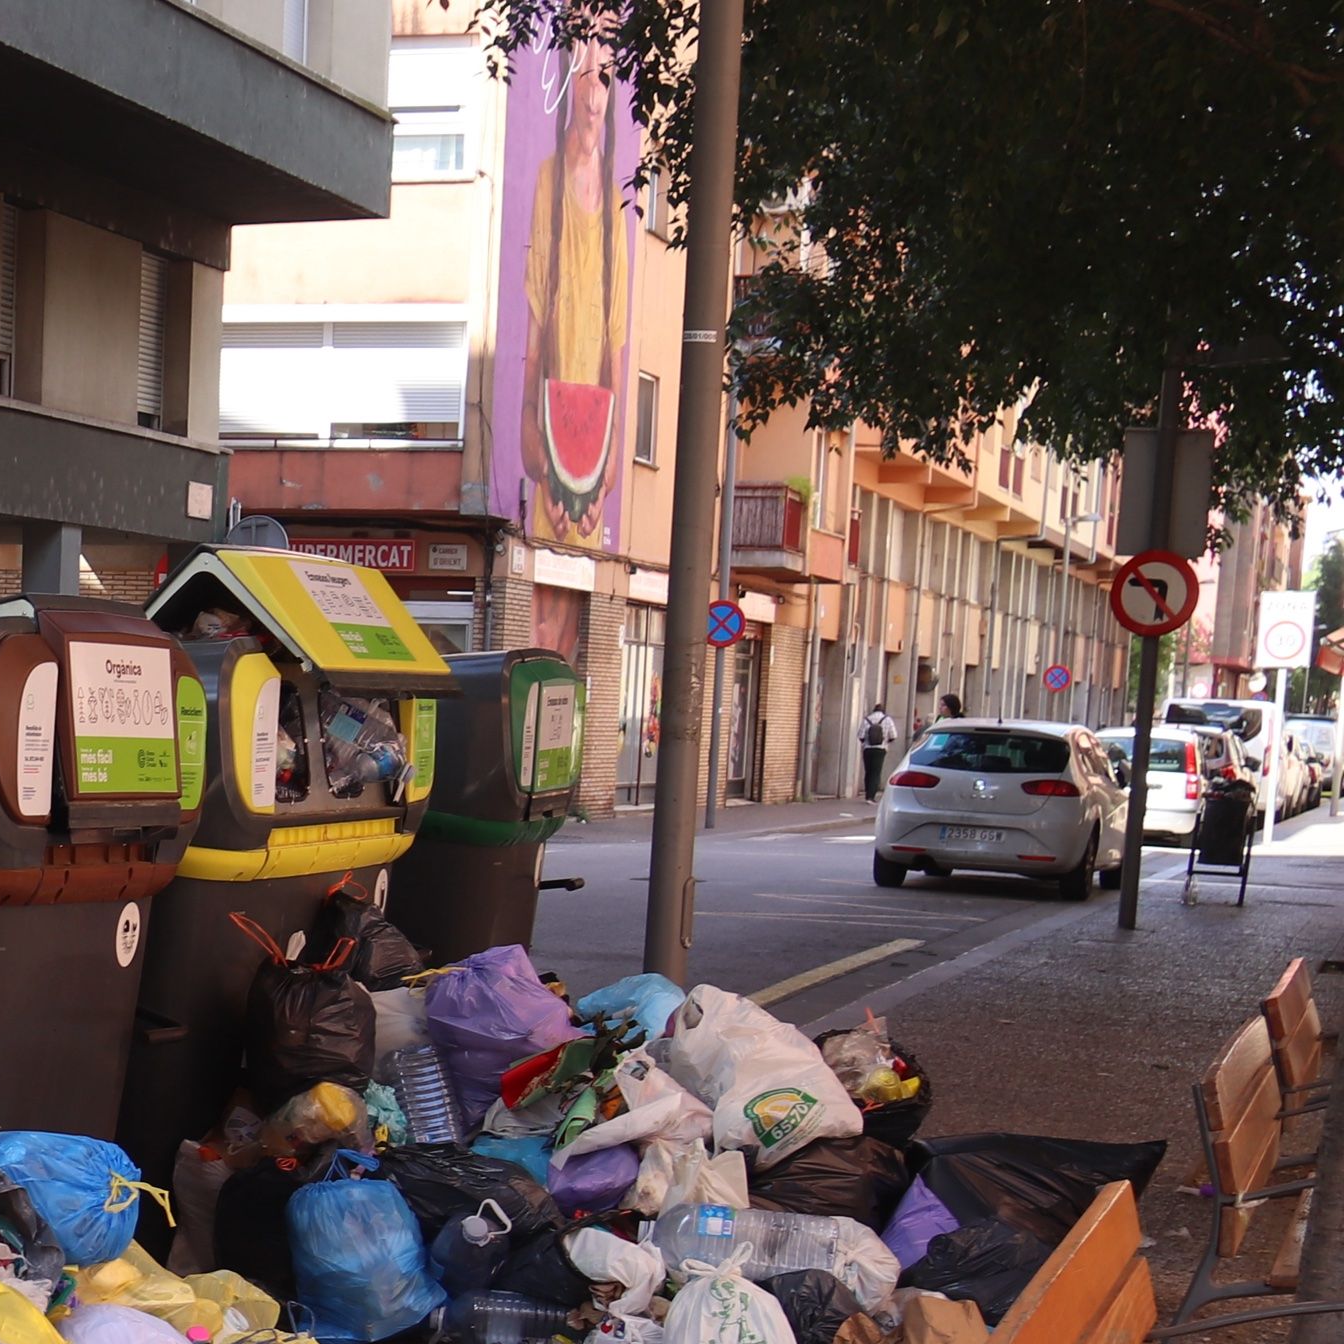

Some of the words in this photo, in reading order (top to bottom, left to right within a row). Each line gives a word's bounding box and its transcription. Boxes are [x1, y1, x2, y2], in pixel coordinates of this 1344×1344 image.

[287, 544, 411, 567] PERMERCAT
[105, 659, 142, 678] Orgànica
[771, 1103, 808, 1140] 65-70
